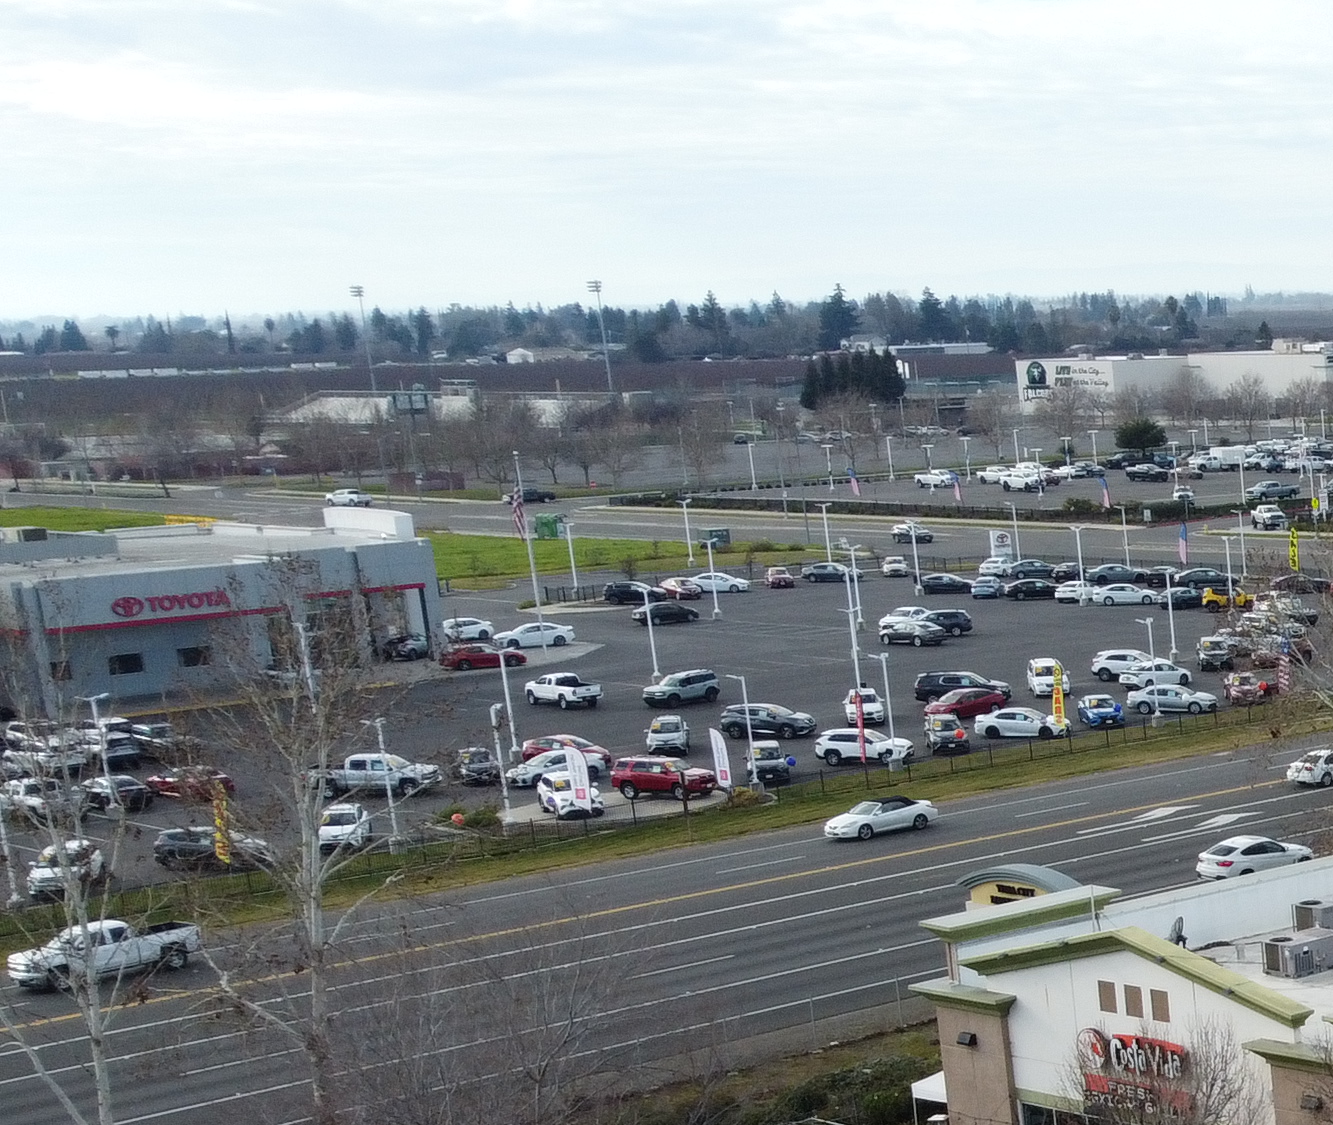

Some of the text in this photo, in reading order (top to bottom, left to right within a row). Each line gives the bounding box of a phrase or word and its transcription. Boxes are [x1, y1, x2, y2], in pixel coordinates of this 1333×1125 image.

[145, 590, 231, 613] TOYOTA
[1109, 1038, 1182, 1079] Costa Vida
